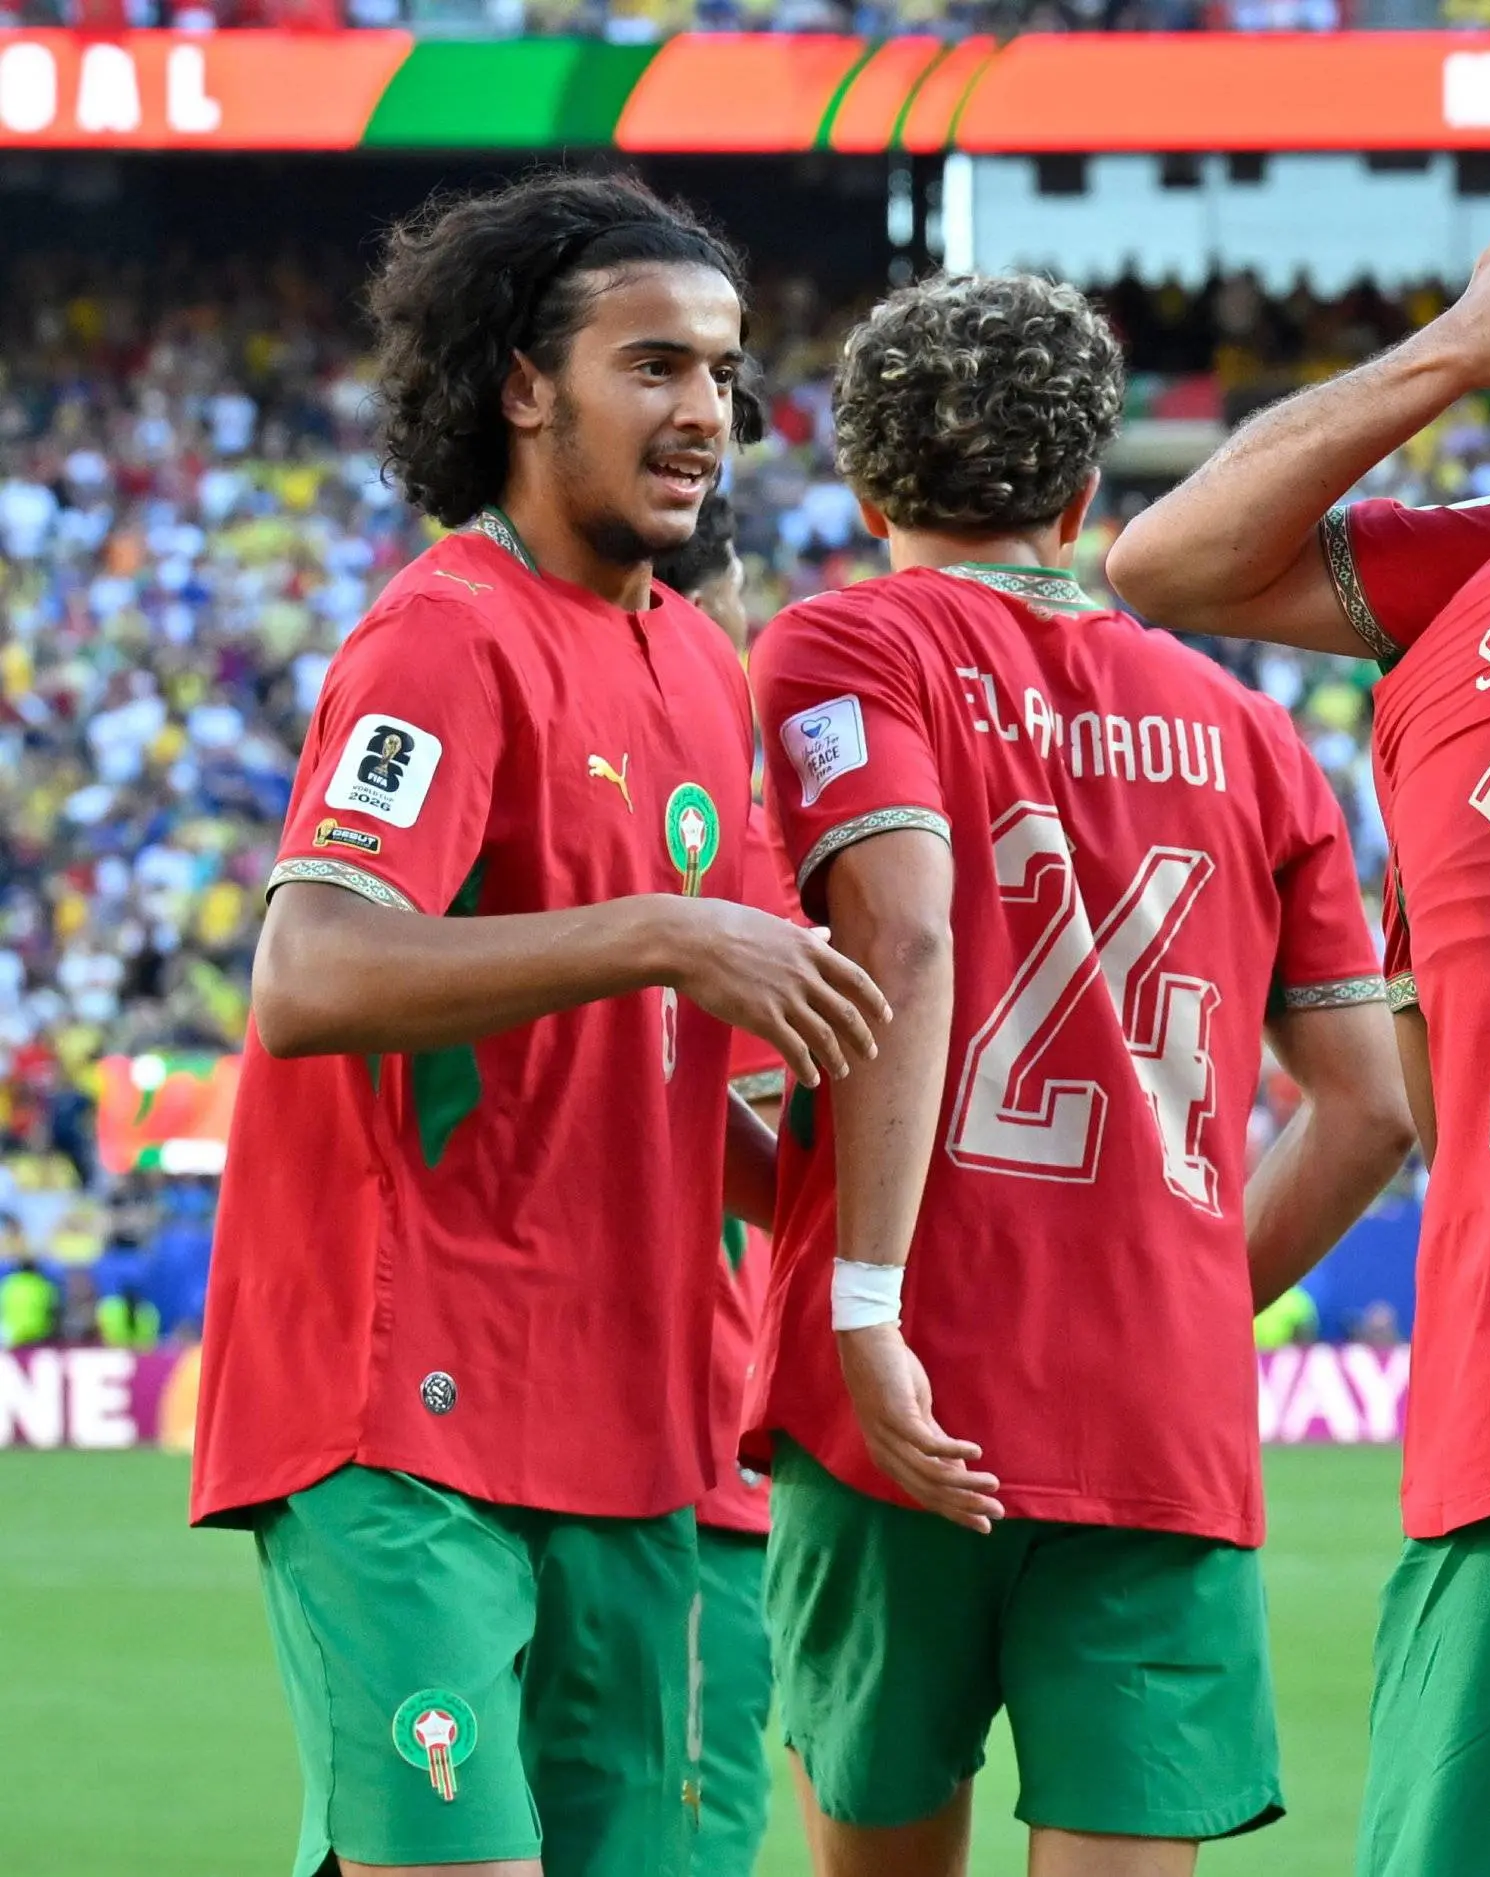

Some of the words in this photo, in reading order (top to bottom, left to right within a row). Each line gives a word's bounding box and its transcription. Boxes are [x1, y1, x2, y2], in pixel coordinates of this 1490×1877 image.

[956, 666, 1019, 742] EL
[348, 791, 391, 812] 2026
[946, 800, 1223, 1218] 24
